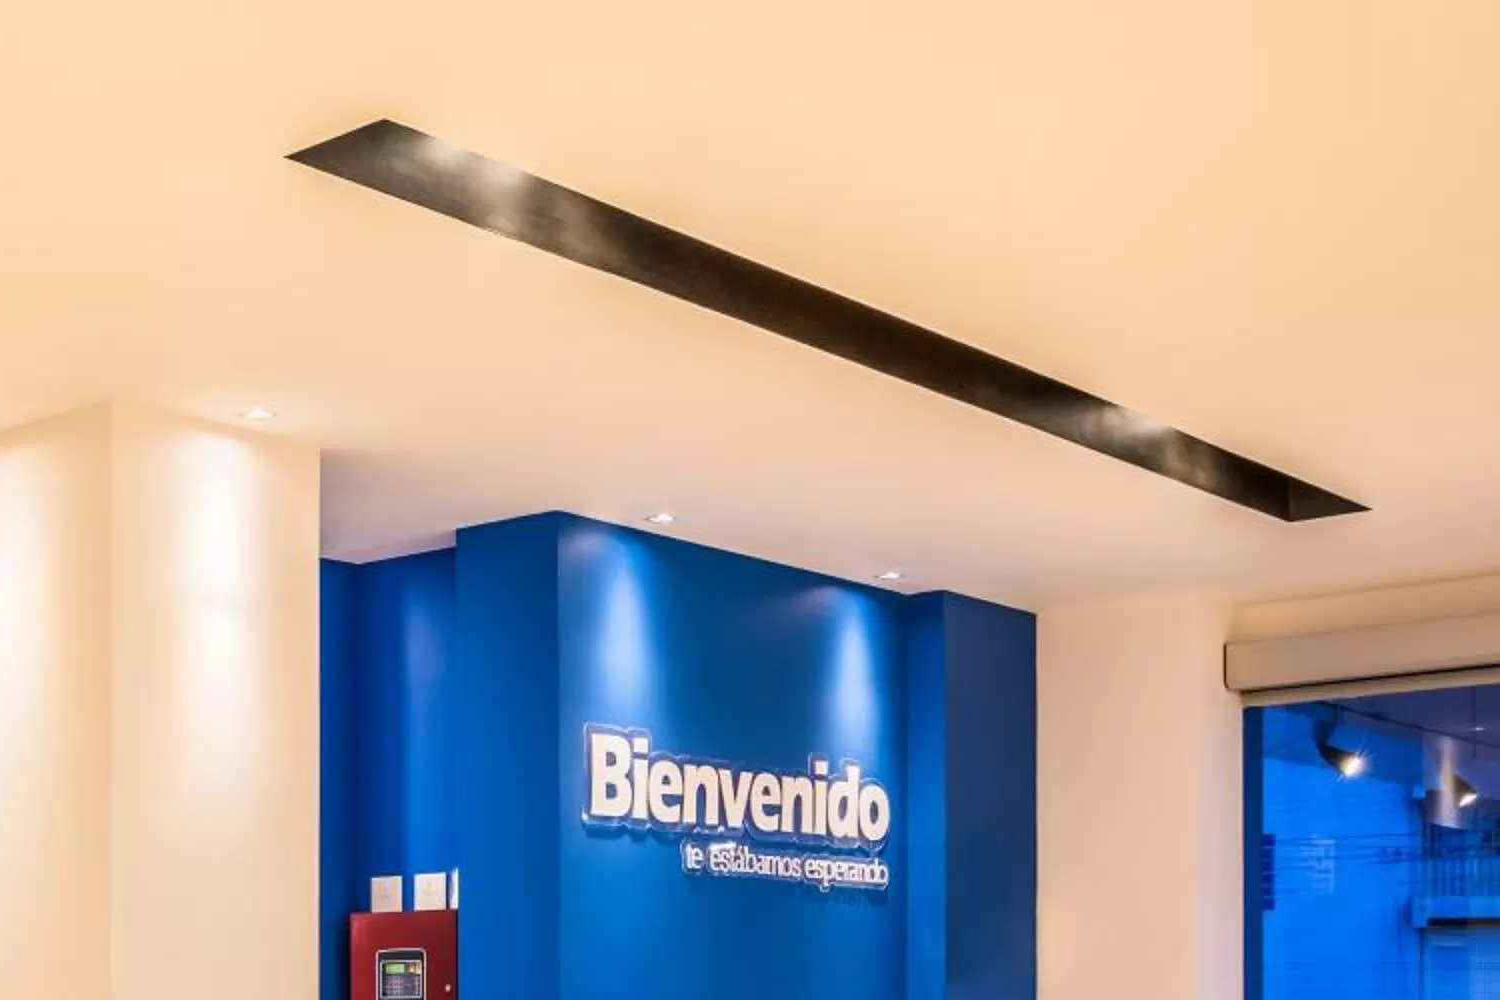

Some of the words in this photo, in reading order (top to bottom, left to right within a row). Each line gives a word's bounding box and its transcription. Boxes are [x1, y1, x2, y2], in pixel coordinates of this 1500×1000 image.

[590, 732, 890, 841] Bienvenido
[685, 843, 704, 870] te
[709, 844, 800, 877] estábamos
[804, 858, 889, 889] esperando
